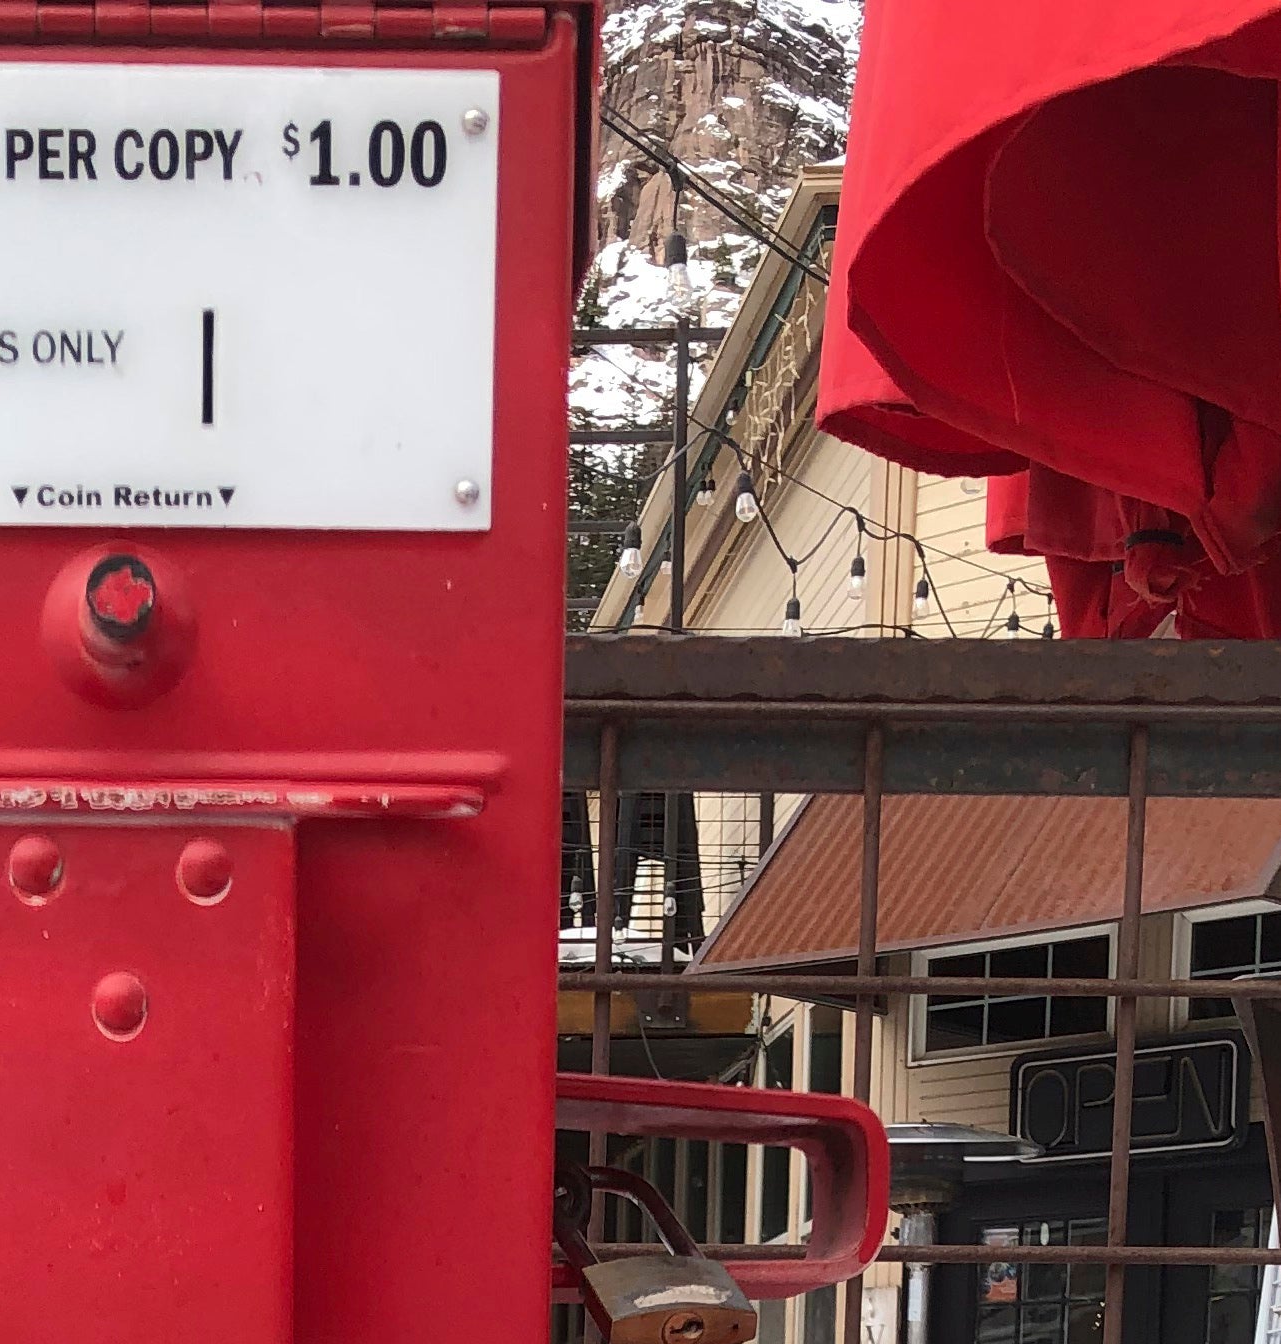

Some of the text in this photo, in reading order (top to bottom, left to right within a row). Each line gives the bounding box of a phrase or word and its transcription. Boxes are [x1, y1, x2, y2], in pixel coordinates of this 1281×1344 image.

[4, 128, 98, 181] PER
[114, 128, 243, 181] COPY
[282, 119, 447, 188] $1.00
[31, 329, 124, 365] ONLY
[36, 485, 214, 507] Coin Return
[1025, 1054, 1228, 1147] OPEN
